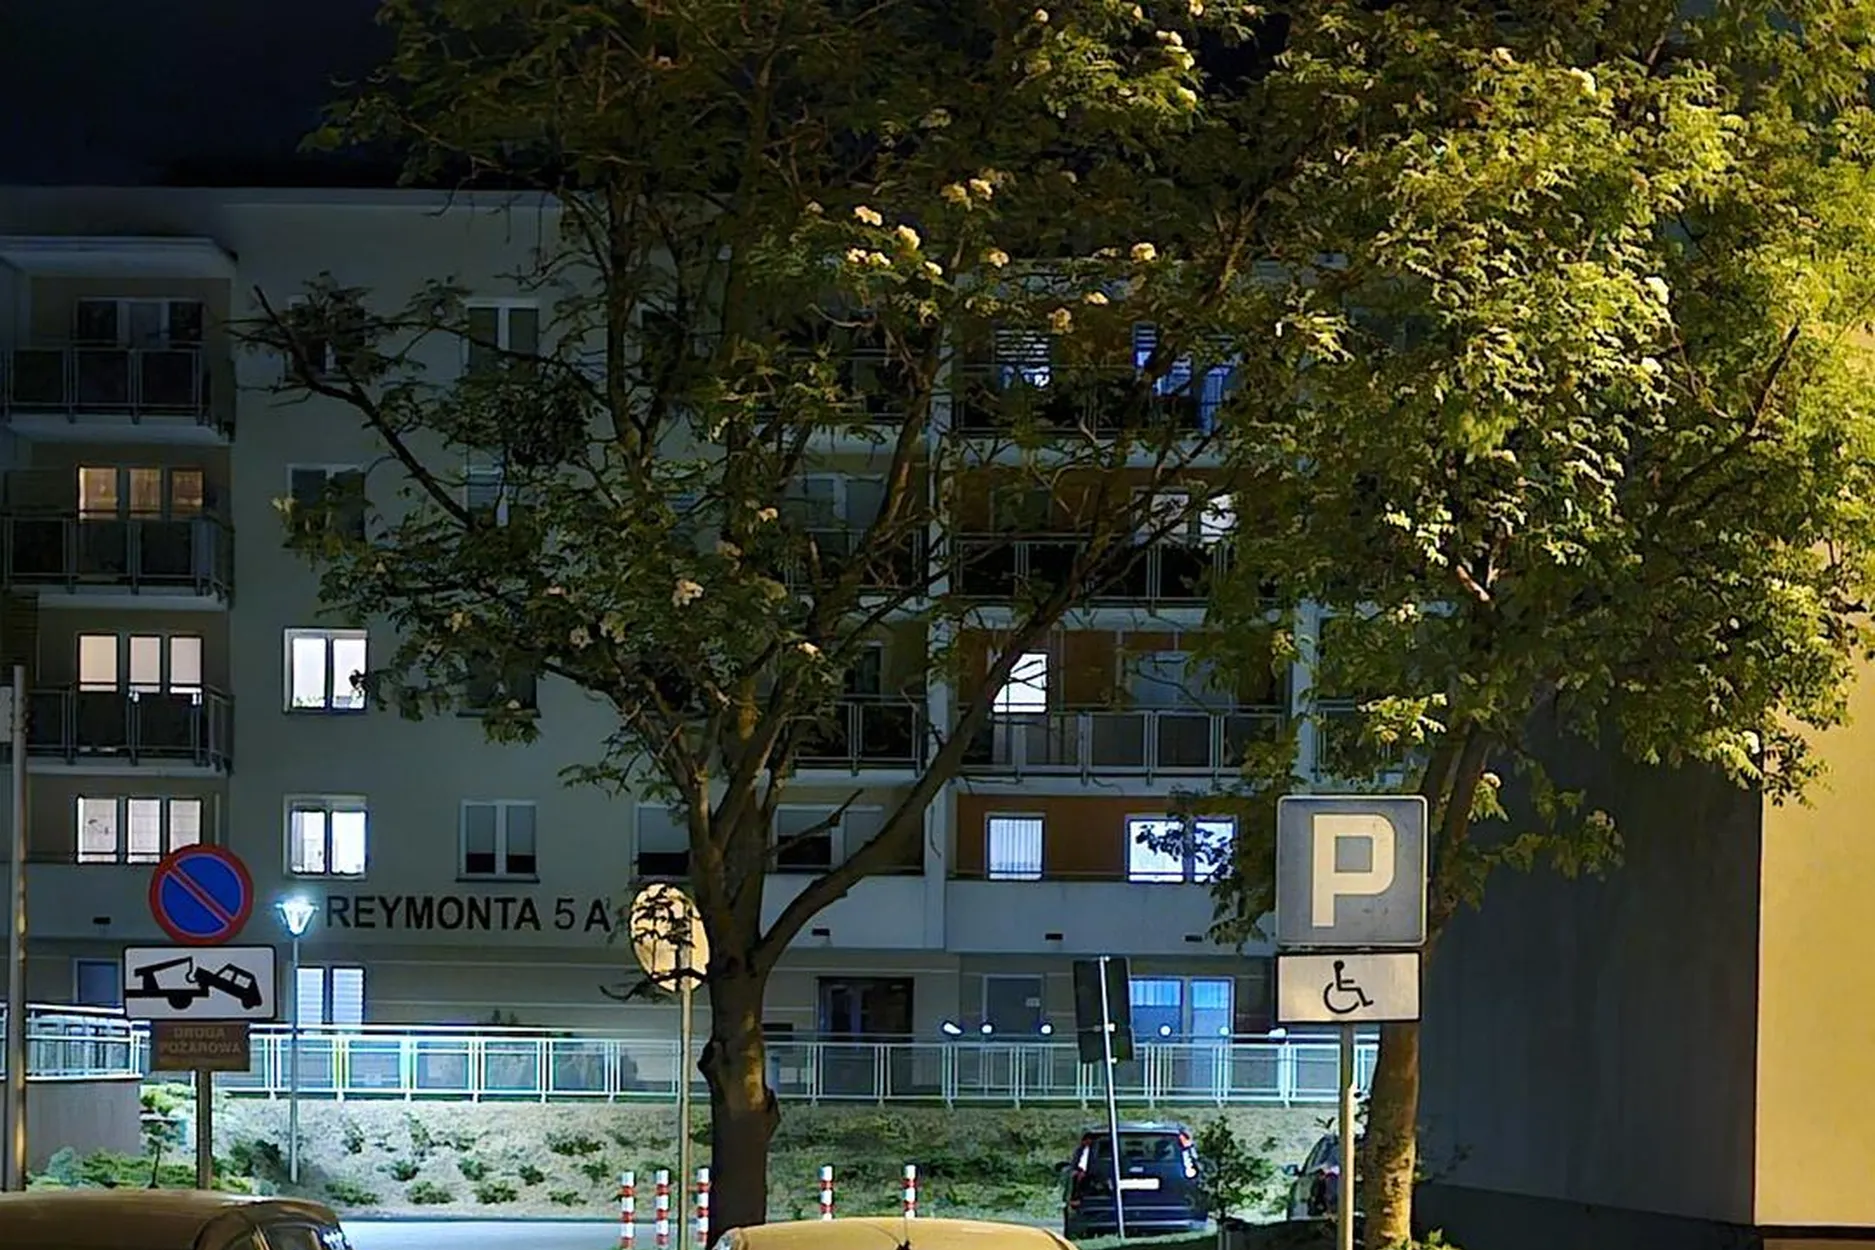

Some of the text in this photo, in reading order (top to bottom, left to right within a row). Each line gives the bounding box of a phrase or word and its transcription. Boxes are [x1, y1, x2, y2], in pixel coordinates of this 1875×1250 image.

[1312, 814, 1395, 927] P
[326, 895, 611, 932] REYMONTA 5 A
